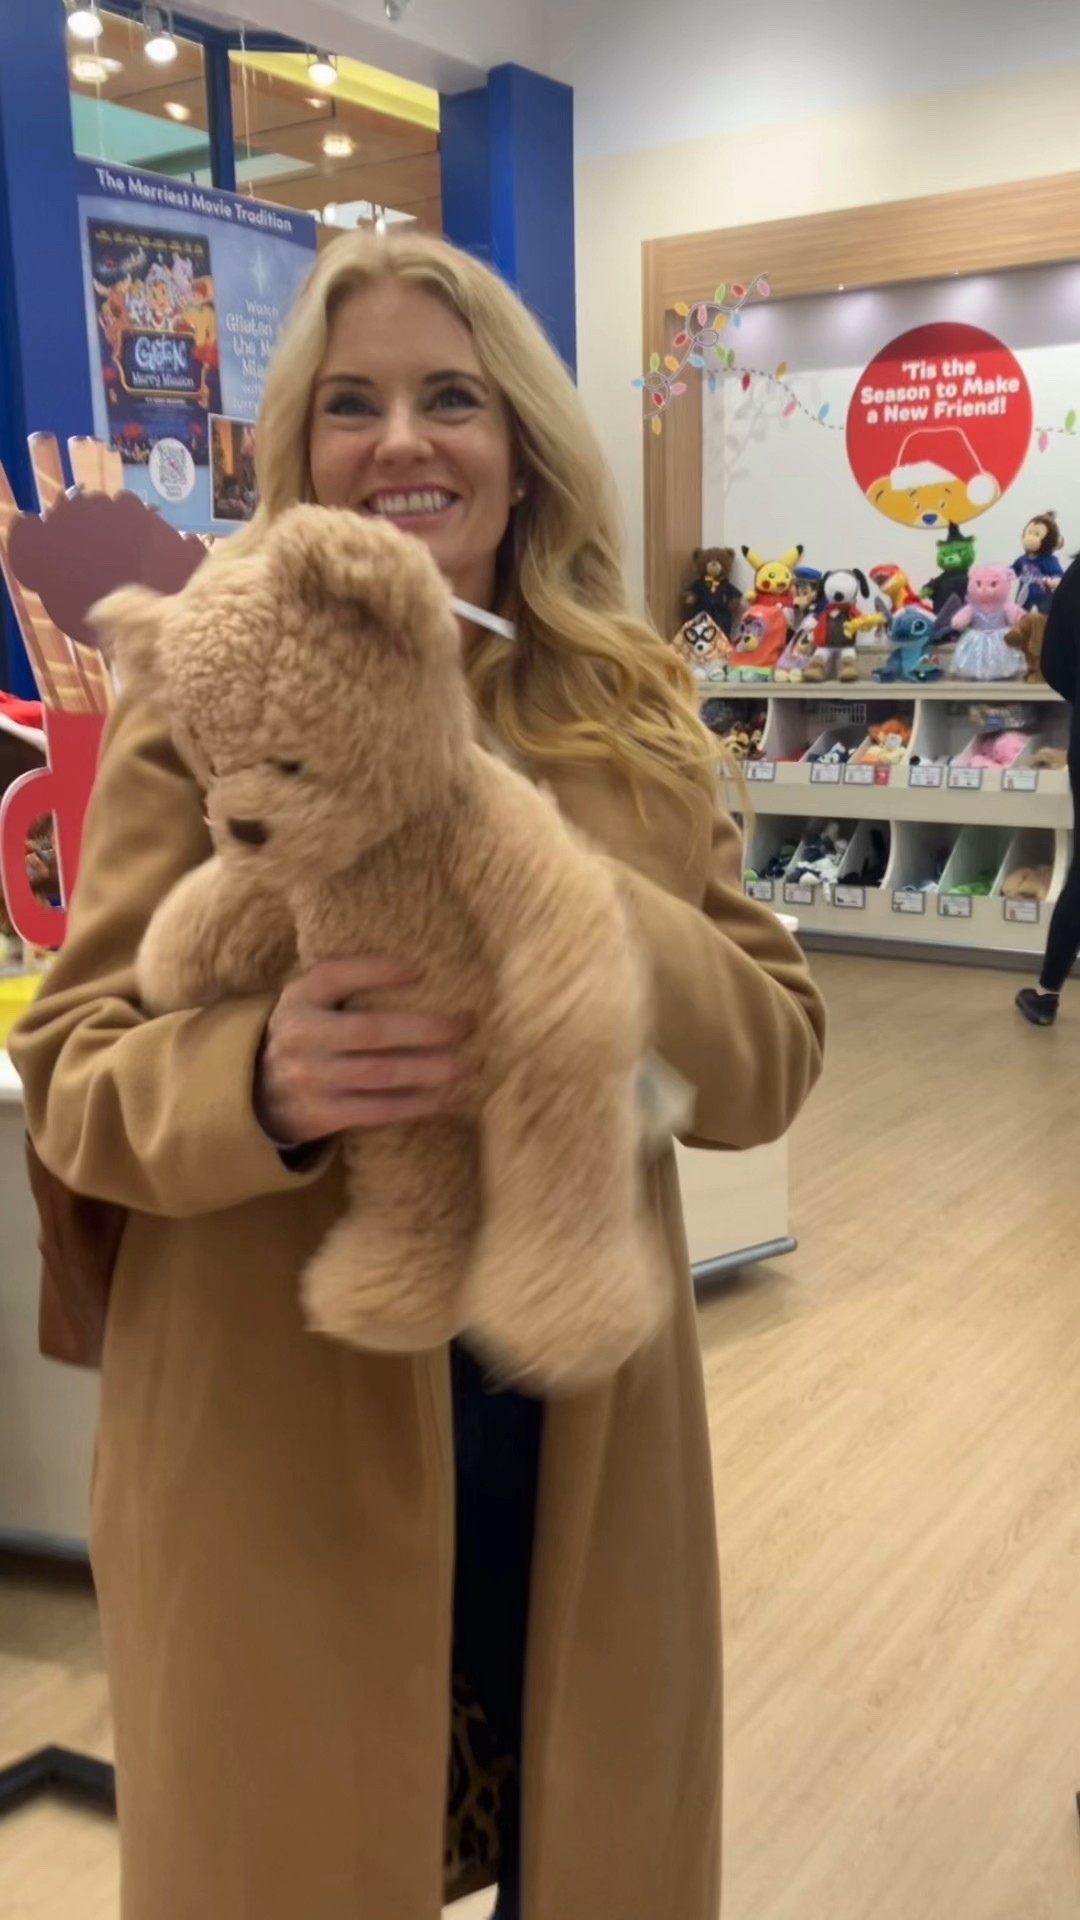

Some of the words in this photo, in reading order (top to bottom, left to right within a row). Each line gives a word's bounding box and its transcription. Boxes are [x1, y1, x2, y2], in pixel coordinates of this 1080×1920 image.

[95, 168, 125, 194] The
[127, 176, 189, 207] Merriest
[192, 193, 232, 217] Movie
[234, 203, 293, 232] Tradition
[245, 299, 279, 317] Watch
[233, 335, 256, 357] the
[903, 360, 937, 380] 'Tis
[942, 358, 976, 377] the
[861, 386, 930, 405] Season
[936, 382, 957, 398] to
[963, 375, 1020, 396] Make
[866, 411, 878, 424] a
[884, 405, 928, 423] New
[934, 397, 1007, 419] Friend!
